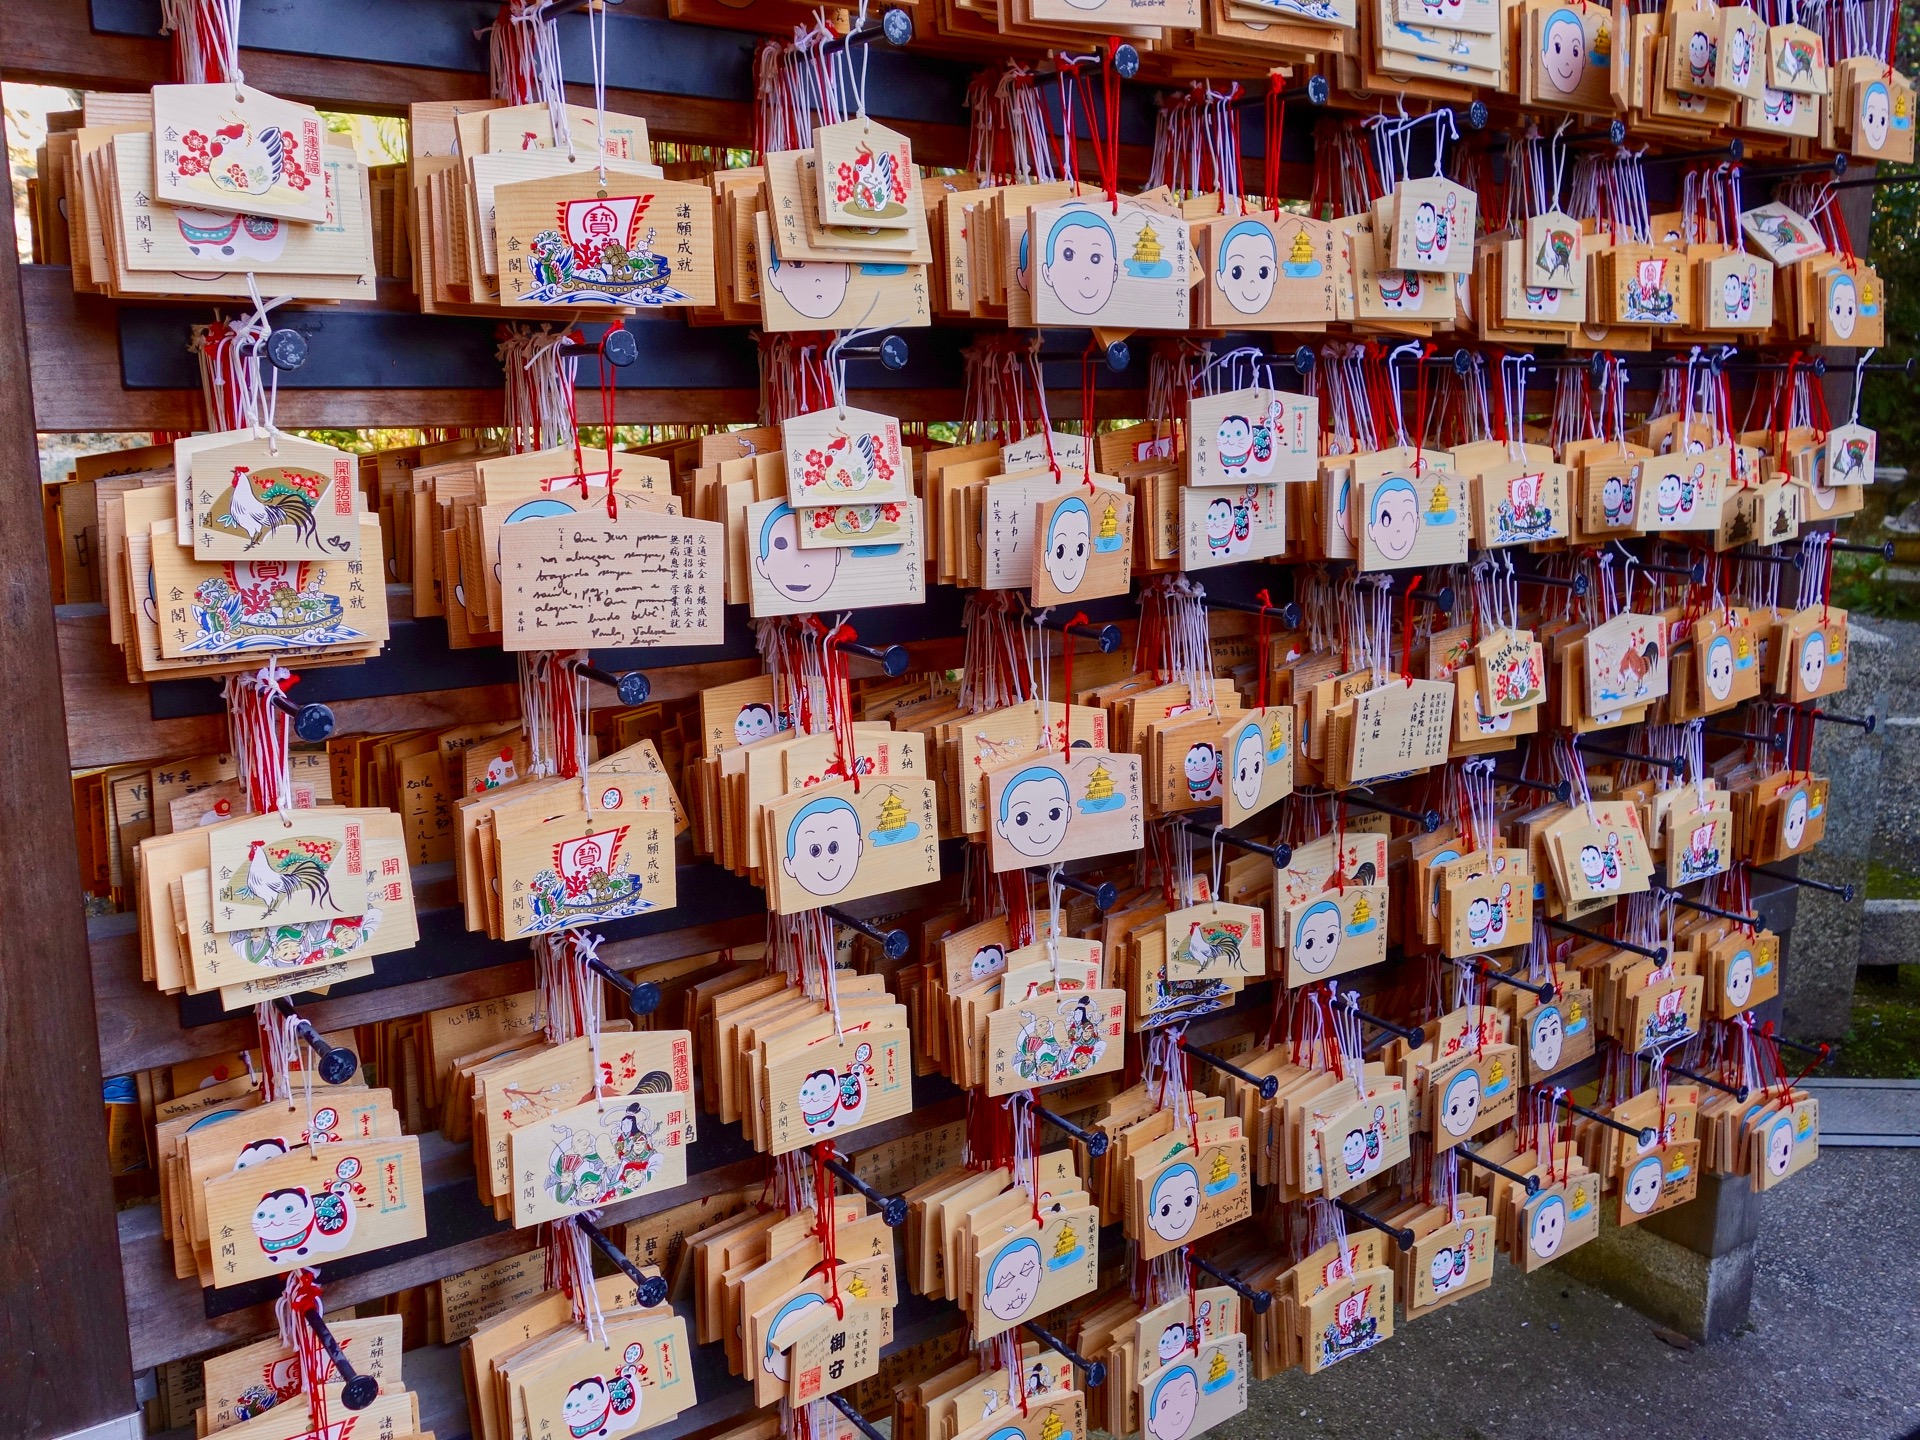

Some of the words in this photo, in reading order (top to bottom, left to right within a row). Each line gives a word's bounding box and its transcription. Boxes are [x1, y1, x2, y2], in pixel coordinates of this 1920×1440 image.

[164, 126, 180, 187] 金閣寺
[302, 118, 321, 177] 開運招福
[900, 142, 911, 189] 開運招福
[826, 161, 838, 213] 金閣寺
[134, 190, 155, 254] 金閣寺
[676, 203, 693, 272] 諸願成就
[782, 195, 797, 245] 金閣寺
[507, 236, 524, 293] 金閣寺
[954, 256, 965, 301] 金閣寺
[1176, 227, 1187, 318] 金閣寺の一休さん
[1325, 229, 1333, 312] 金閣寺の一休さん
[1338, 273, 1347, 312] 金閣寺
[1362, 269, 1370, 307] 金閣寺
[886, 423, 900, 467] 開運招福
[1197, 436, 1206, 477] 金閣寺
[335, 460, 351, 515] 開運招福
[792, 450, 806, 496] 金閣寺
[198, 489, 213, 548] 金閣寺
[804, 509, 816, 539] 閣寺
[1165, 510, 1173, 548] 金閣寺
[1190, 521, 1198, 560] 金閣寺
[683, 535, 694, 580] 開運招福
[696, 535, 707, 579] 交通安全
[1122, 501, 1133, 584] 金閣寺の一休さん
[347, 549, 366, 610] 願成就
[169, 586, 189, 643] 金閣寺
[683, 585, 694, 628] 家内安全
[697, 585, 708, 628] 良縁成就
[902, 745, 913, 769] 奉納
[969, 784, 978, 825] 金閣寺
[1129, 761, 1140, 840] 金閣寺の一休さん
[1168, 764, 1176, 801] 金閣寺
[346, 824, 361, 875] 開運招福
[922, 787, 935, 872] 金閣寺の一休さん
[647, 828, 659, 884] 諸願成就
[1570, 862, 1578, 892] 金閣寺
[219, 865, 235, 920] 金閣寺
[382, 858, 402, 902] 開運
[512, 880, 525, 926] 金閣寺
[1378, 892, 1386, 955] 金閣寺の一休さん
[201, 920, 220, 974] 金閣寺
[1171, 938, 1180, 975] 金閣寺
[1145, 970, 1153, 1005] 金閣寺
[1109, 1005, 1122, 1036] 開運
[674, 1041, 689, 1091] 開運招福
[887, 1048, 895, 1083] 寺まいり
[995, 1049, 1005, 1086] 金閣寺
[667, 1110, 682, 1147] 開運
[778, 1101, 788, 1142] 金閣寺
[385, 1163, 397, 1204] 寺まいり
[496, 1141, 509, 1185] 金閣寺
[523, 1170, 536, 1214] 金閣寺
[220, 1225, 236, 1273] 金閣寺
[1087, 1214, 1096, 1284] 金閣寺の一休さん
[661, 1343, 672, 1378] 寺まいり
[829, 1331, 845, 1379] 御守
[1314, 1332, 1322, 1362] 金閣寺
